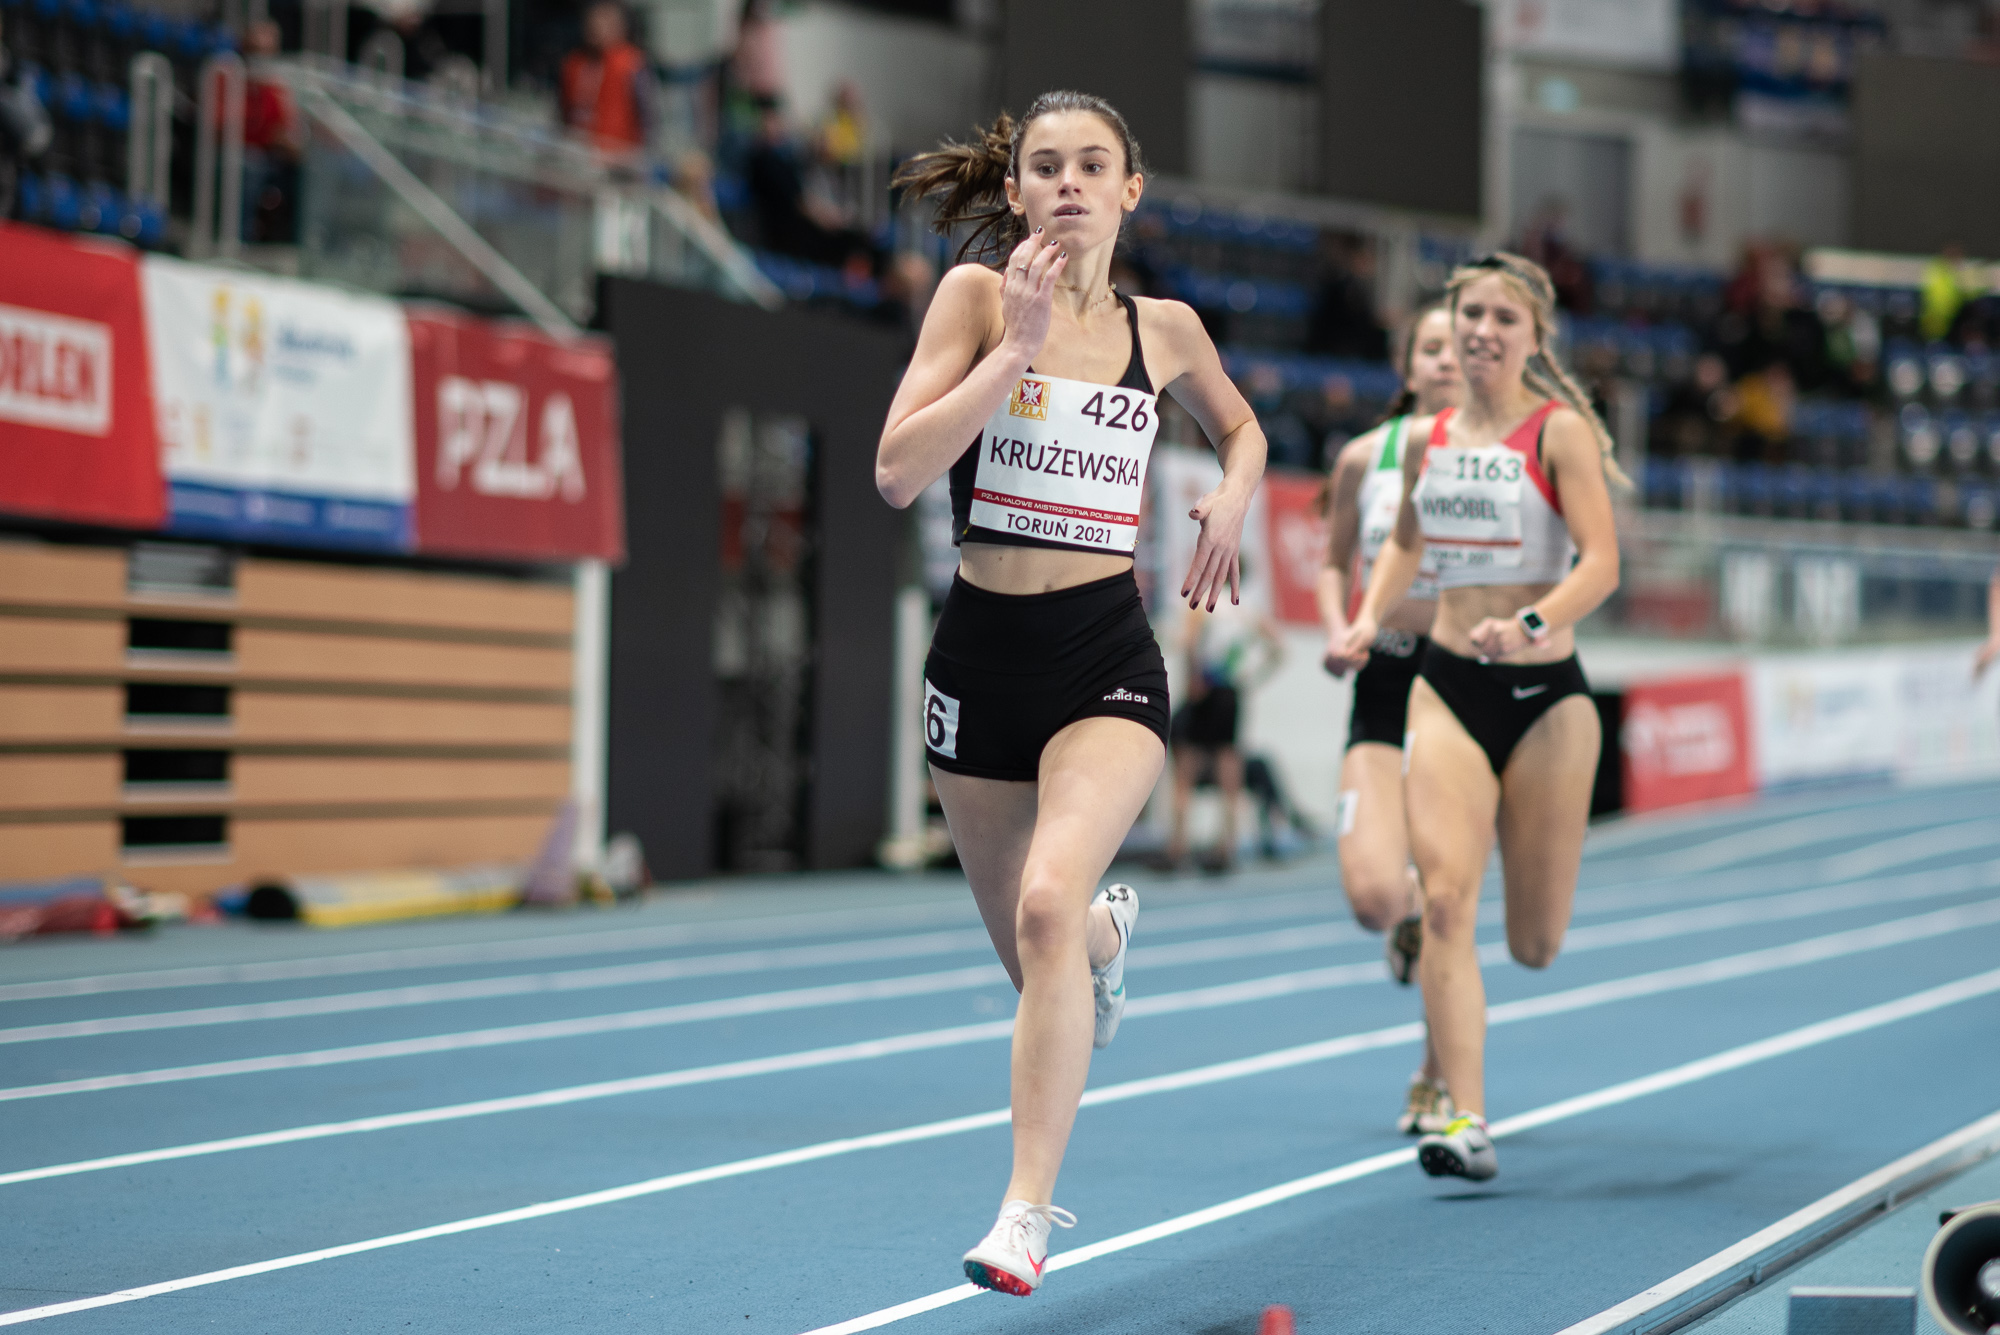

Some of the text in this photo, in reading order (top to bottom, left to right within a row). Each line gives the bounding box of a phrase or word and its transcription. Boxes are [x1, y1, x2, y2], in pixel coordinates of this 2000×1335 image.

[1011, 403, 1044, 419] PZLA
[1081, 391, 1149, 432] 426
[437, 375, 585, 503] PZLA
[990, 436, 1139, 487] KRUŻEWSKA
[1456, 455, 1521, 482] 1163
[981, 492, 1001, 501] PZLA
[1001, 496, 1033, 508] HALOWE
[1033, 503, 1089, 517] MISTRZOSTWA
[1090, 511, 1113, 520] POLSKI
[1421, 495, 1501, 521] WRÓBEL
[1007, 513, 1112, 544] TORUŃ 2021
[1103, 692, 1148, 704] adidas
[926, 694, 947, 748] 6
